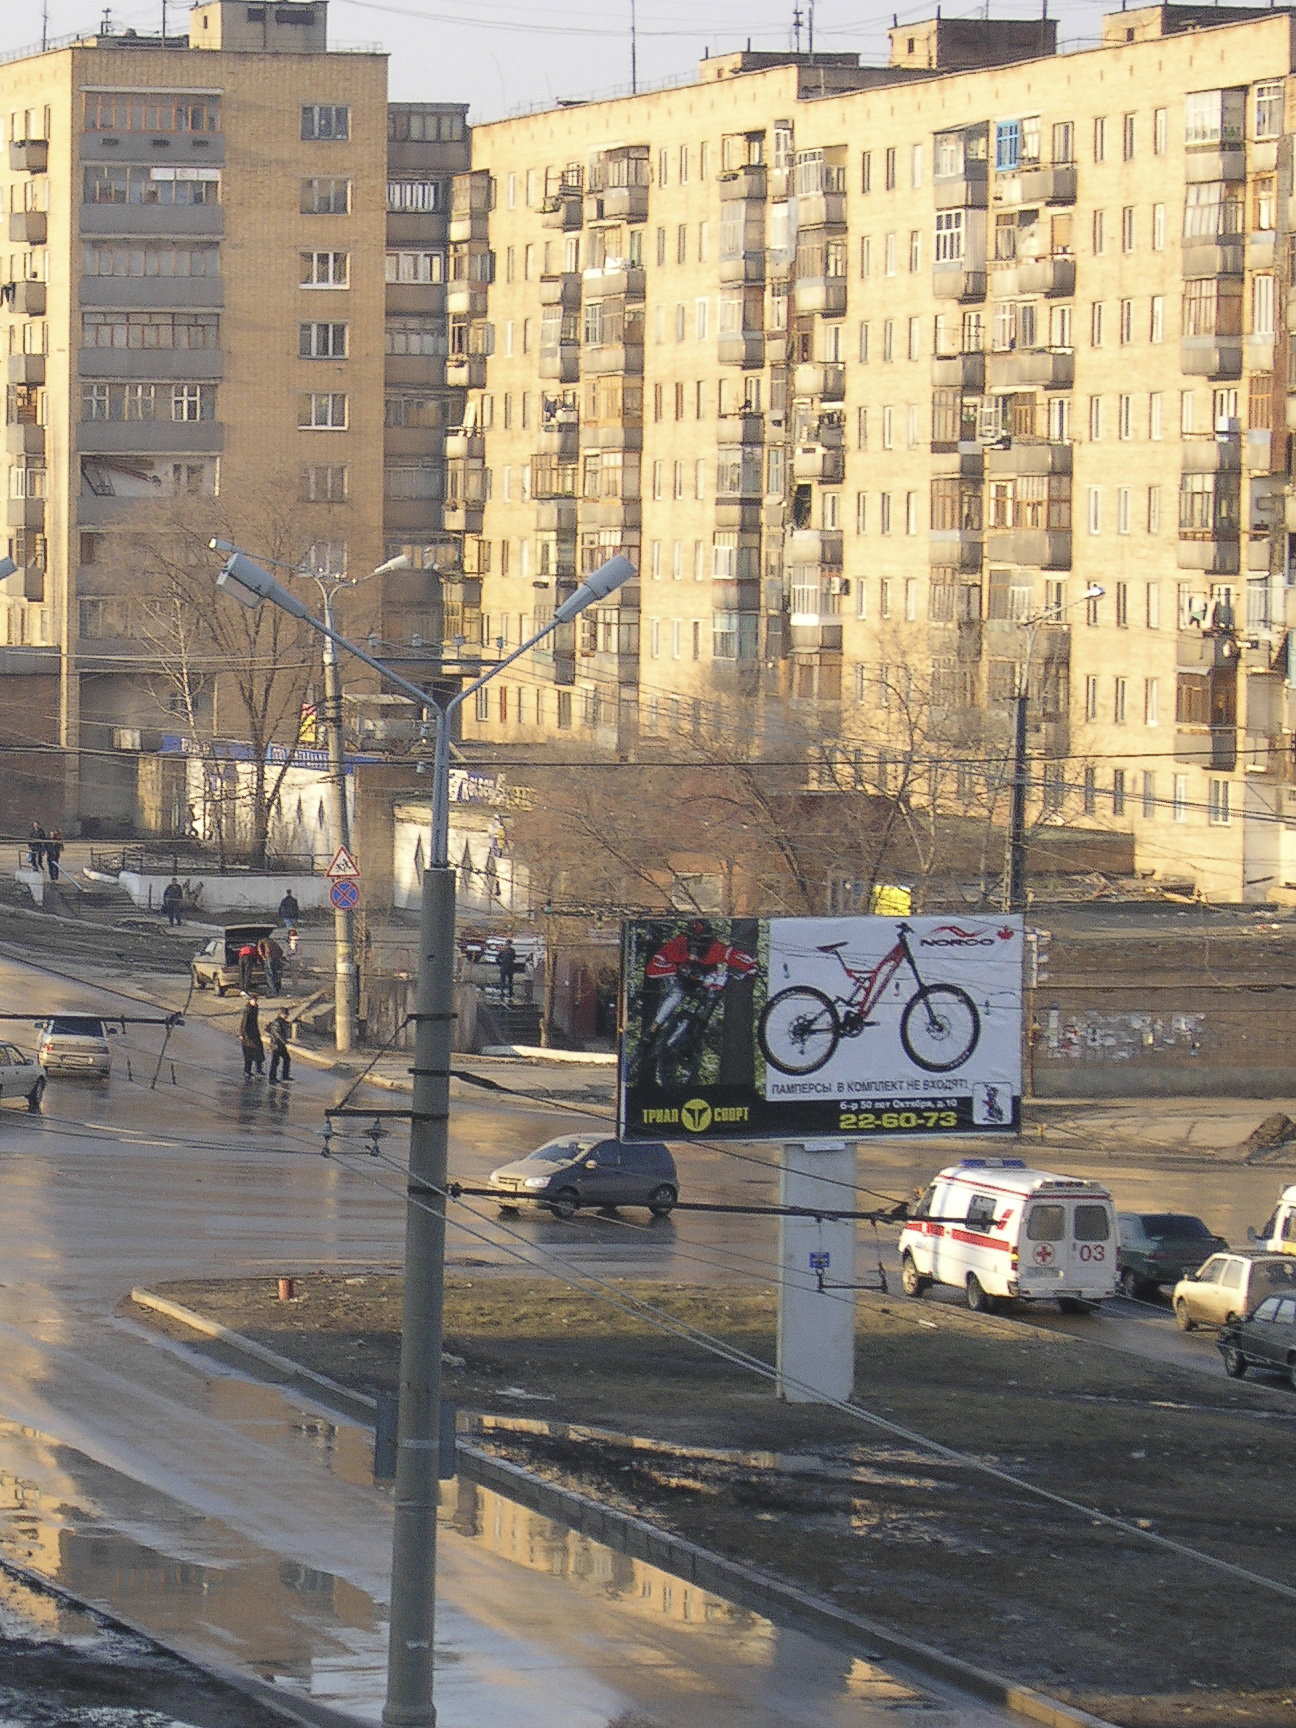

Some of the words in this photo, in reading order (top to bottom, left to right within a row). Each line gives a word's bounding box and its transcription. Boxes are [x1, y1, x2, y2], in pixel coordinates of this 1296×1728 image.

[920, 938, 995, 947] NORCO
[772, 1081, 832, 1094] ПАМПЕРСЫ
[837, 1081, 845, 1092] В
[847, 1080, 905, 1092] КОМПЛЕКТ
[907, 1079, 921, 1090] НЕ
[860, 1100, 872, 1109] 50
[642, 1108, 679, 1123] ТРИАЛ
[713, 1107, 749, 1122] СПОРТ
[839, 1111, 958, 1129] 22-60-73
[1079, 1244, 1105, 1262] 03
